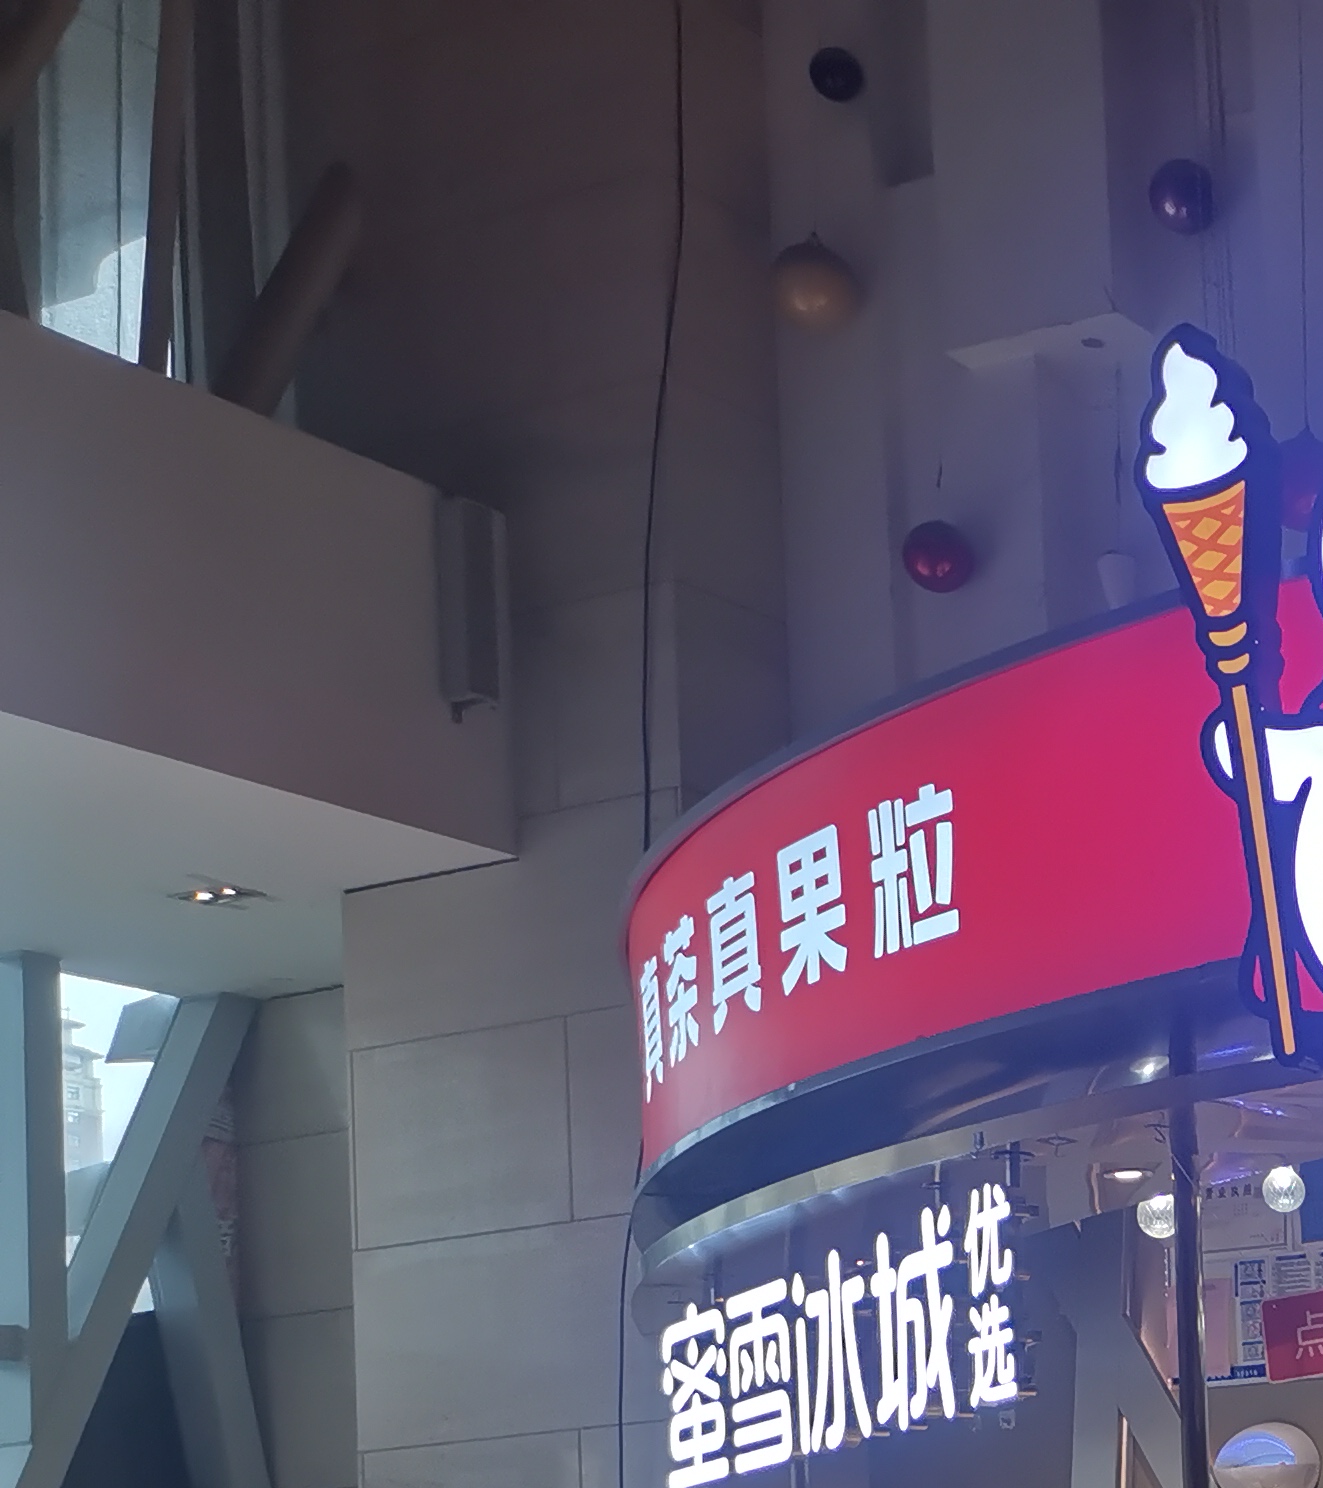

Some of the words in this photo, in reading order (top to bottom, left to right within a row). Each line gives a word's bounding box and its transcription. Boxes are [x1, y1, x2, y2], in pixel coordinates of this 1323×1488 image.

[640, 783, 960, 1104] 真茶真果粒
[963, 1182, 1019, 1413] 优选
